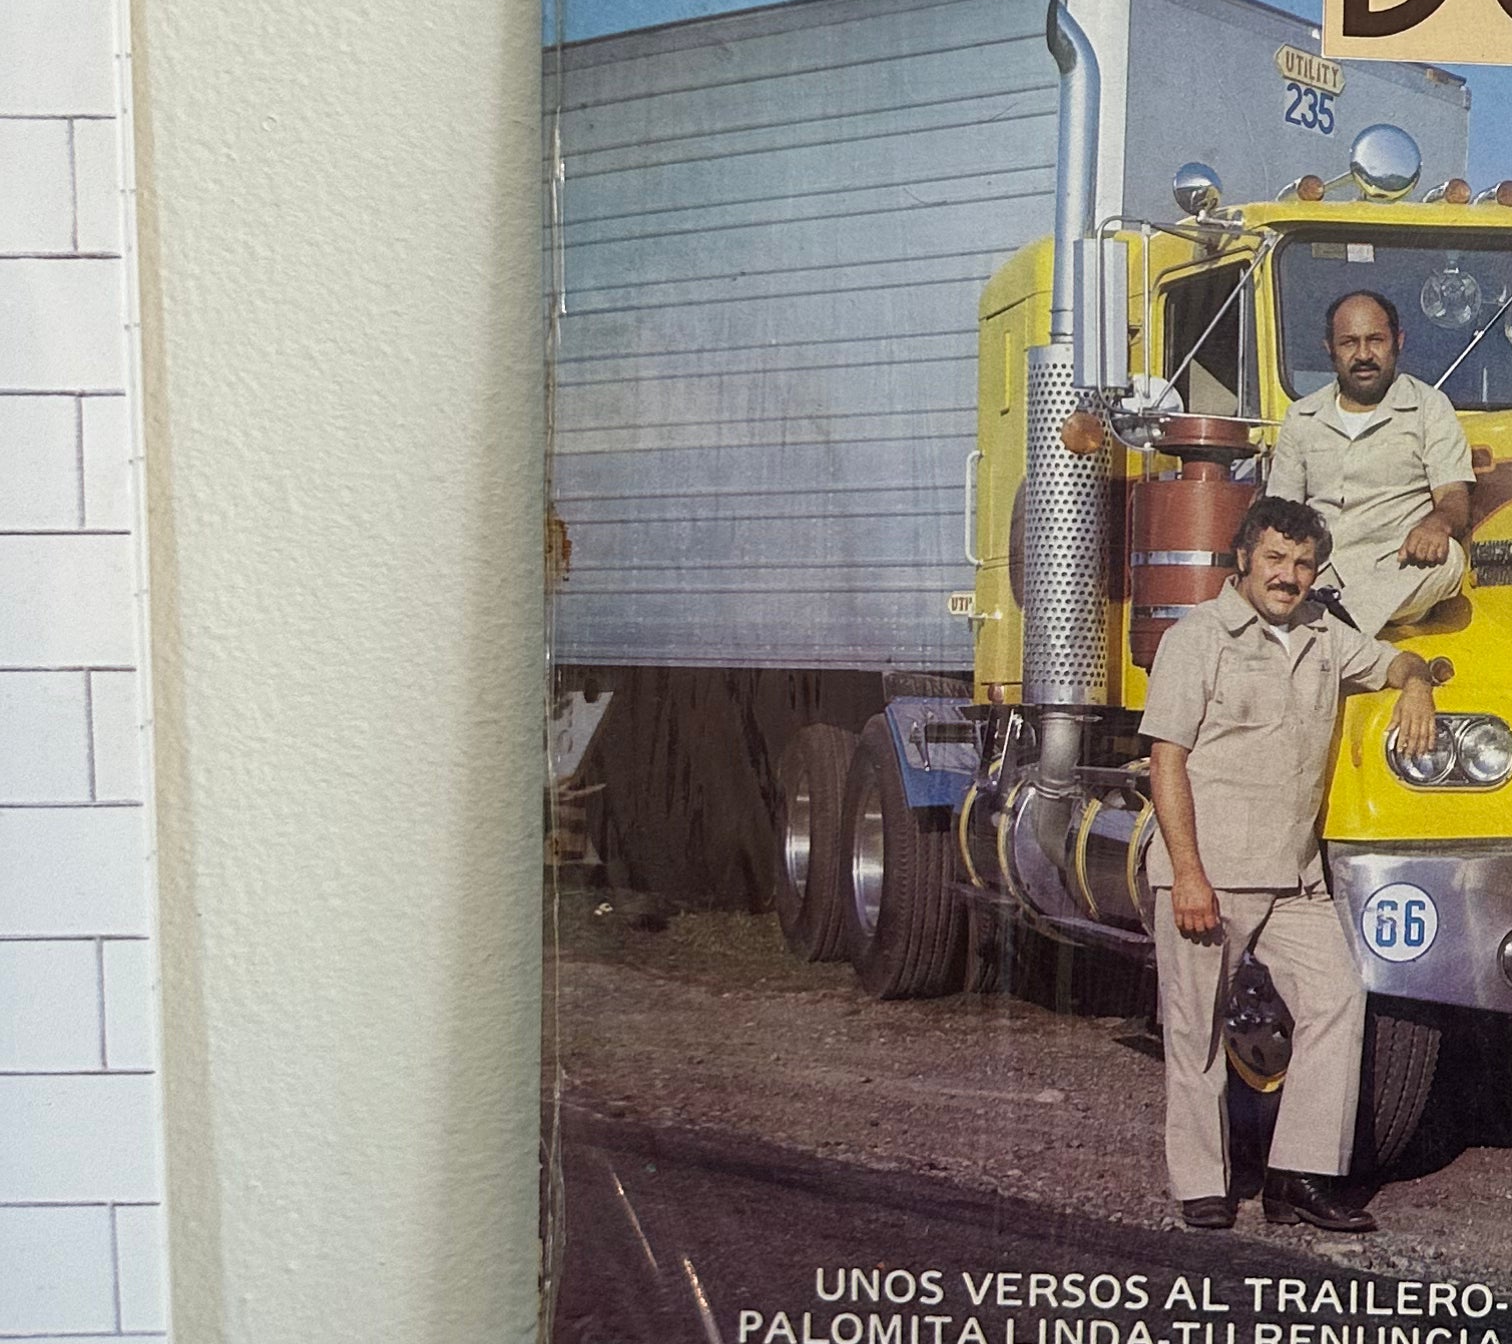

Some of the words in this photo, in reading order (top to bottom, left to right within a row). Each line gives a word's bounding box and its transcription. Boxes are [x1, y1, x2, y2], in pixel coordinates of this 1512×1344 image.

[1286, 50, 1339, 88] UTILITY
[1285, 82, 1334, 134] 235
[1375, 899, 1426, 948] 66
[816, 1267, 944, 1305] UNOS
[962, 1271, 1149, 1309] VERSOS
[1164, 1276, 1230, 1312] AL
